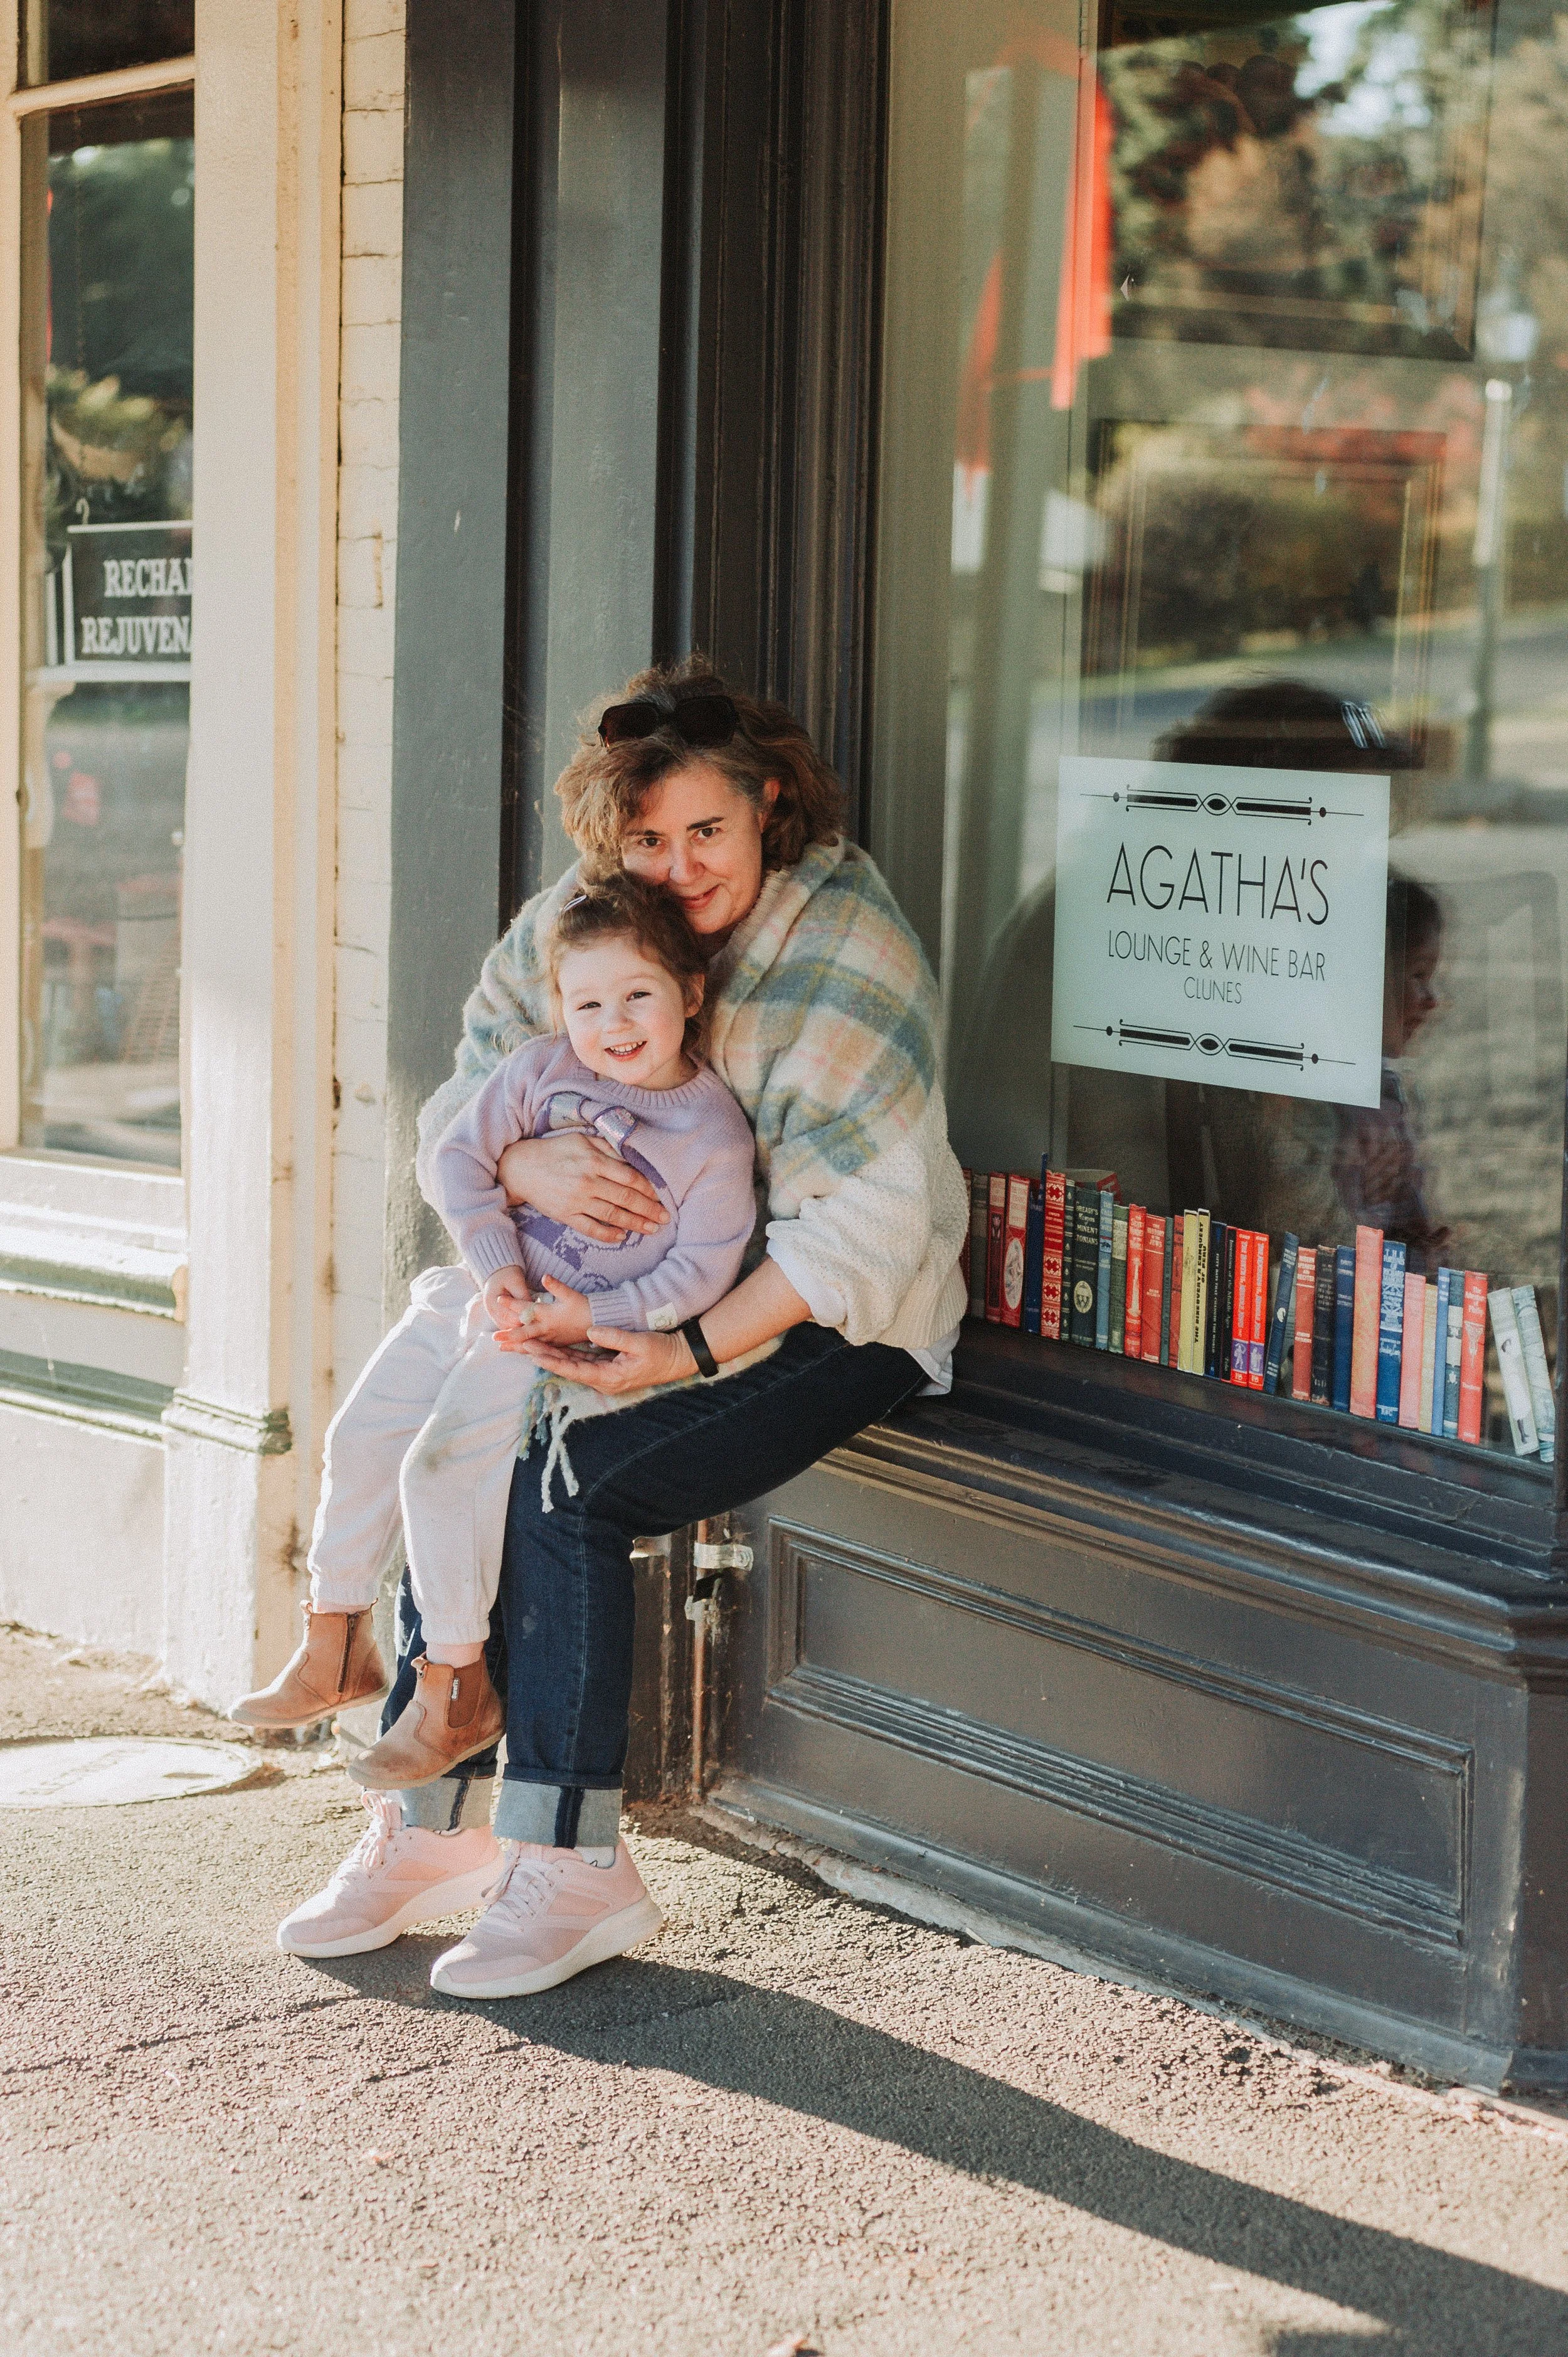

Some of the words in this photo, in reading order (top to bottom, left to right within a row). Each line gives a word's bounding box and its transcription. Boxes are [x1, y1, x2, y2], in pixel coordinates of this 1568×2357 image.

[81, 616, 190, 654] REJUVEN
[1107, 841, 1329, 925] AGATHA'S
[1108, 930, 1191, 967] LOUNGE
[1199, 940, 1213, 969] &
[1222, 942, 1279, 977] WINE
[1288, 949, 1325, 981] BAR
[1184, 976, 1242, 1004] CLUNES
